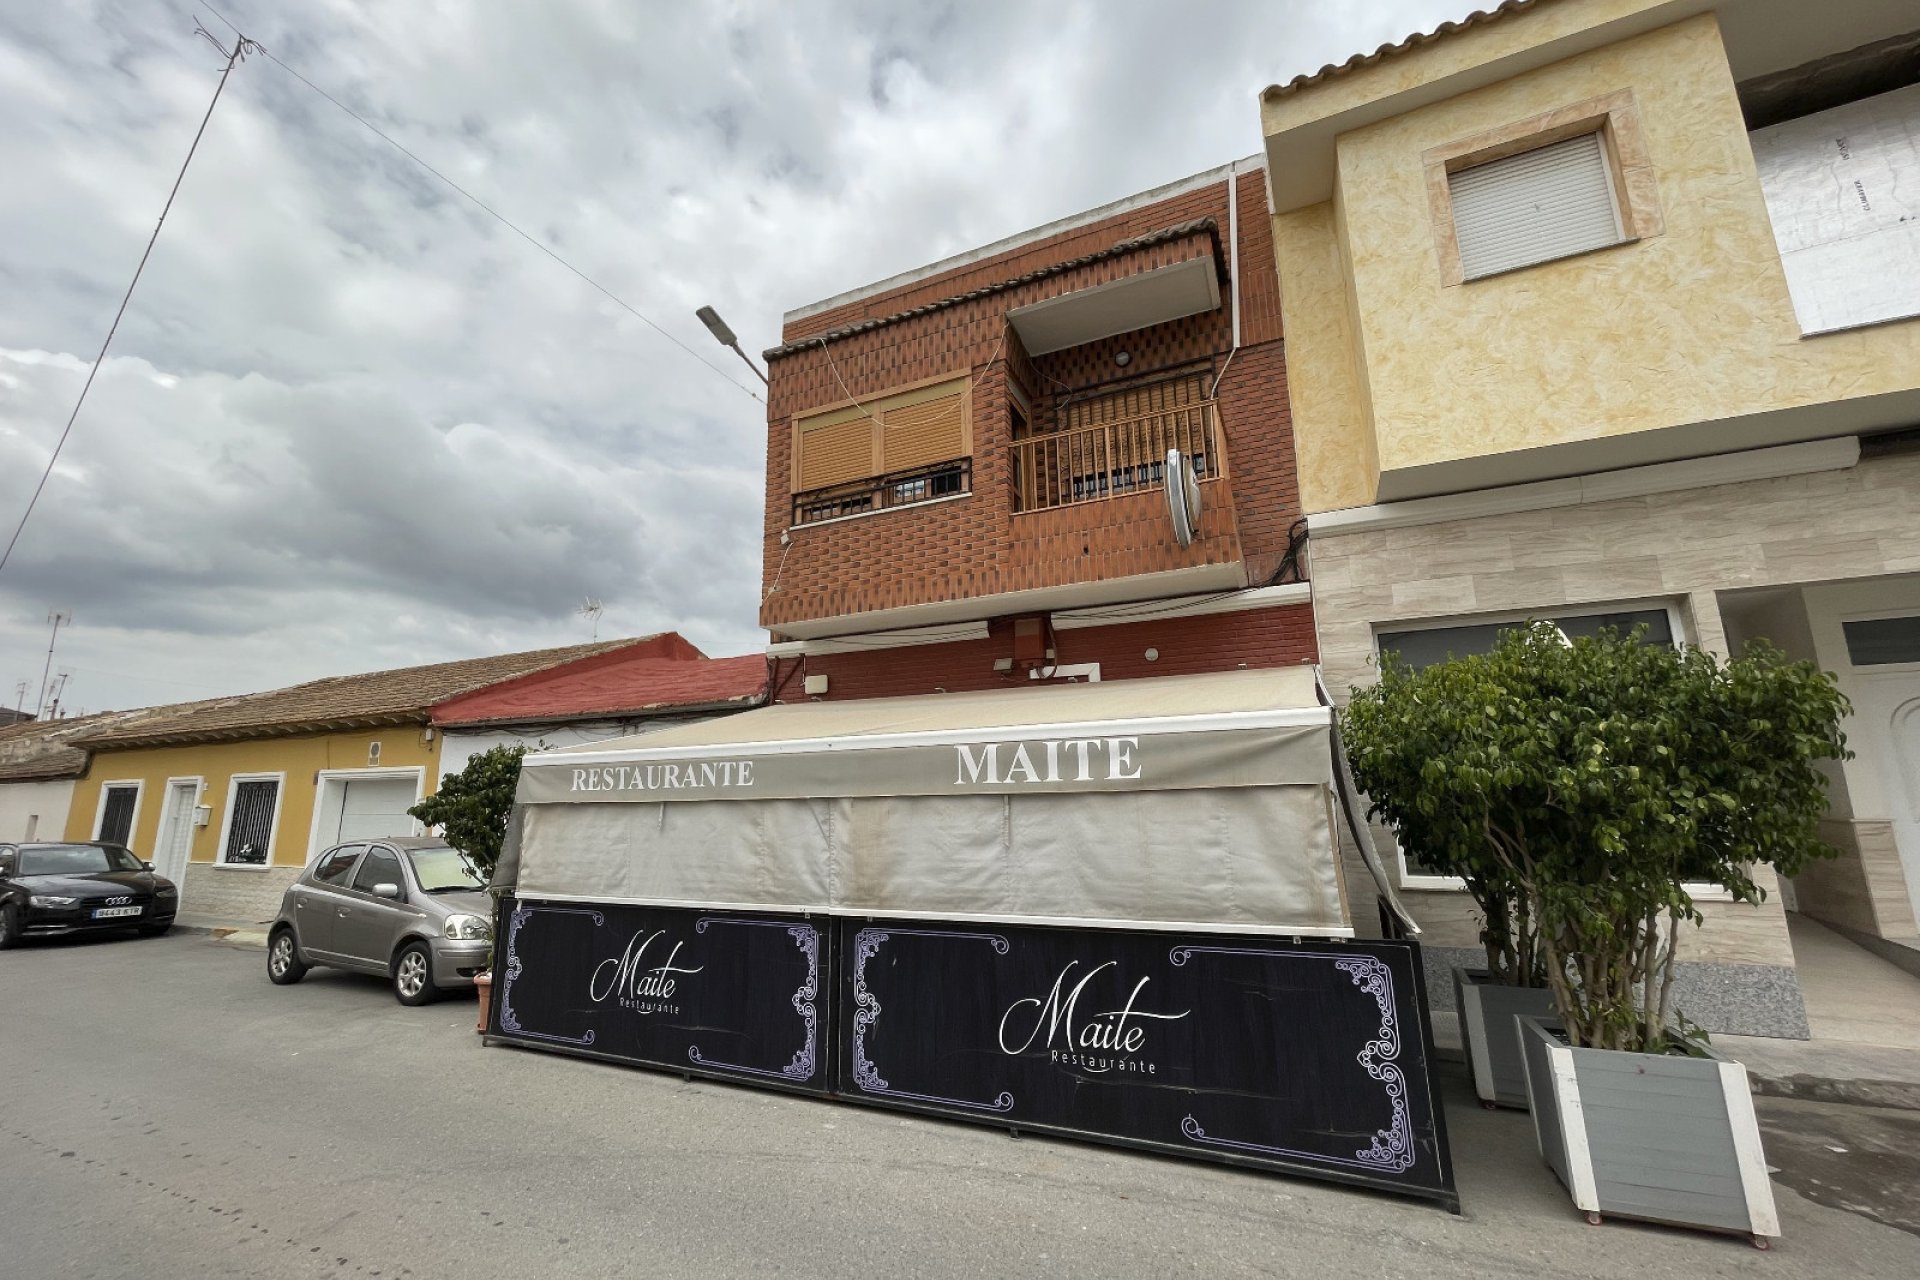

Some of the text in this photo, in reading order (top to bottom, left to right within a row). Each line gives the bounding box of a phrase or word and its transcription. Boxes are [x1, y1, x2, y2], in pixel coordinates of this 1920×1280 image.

[570, 737, 1142, 792] RESTAURANTE MAITE
[590, 929, 704, 1002] Maite
[620, 997, 680, 1015] Restaurante
[999, 960, 1191, 1055] Maite
[1051, 1050, 1156, 1074] Restaurante
